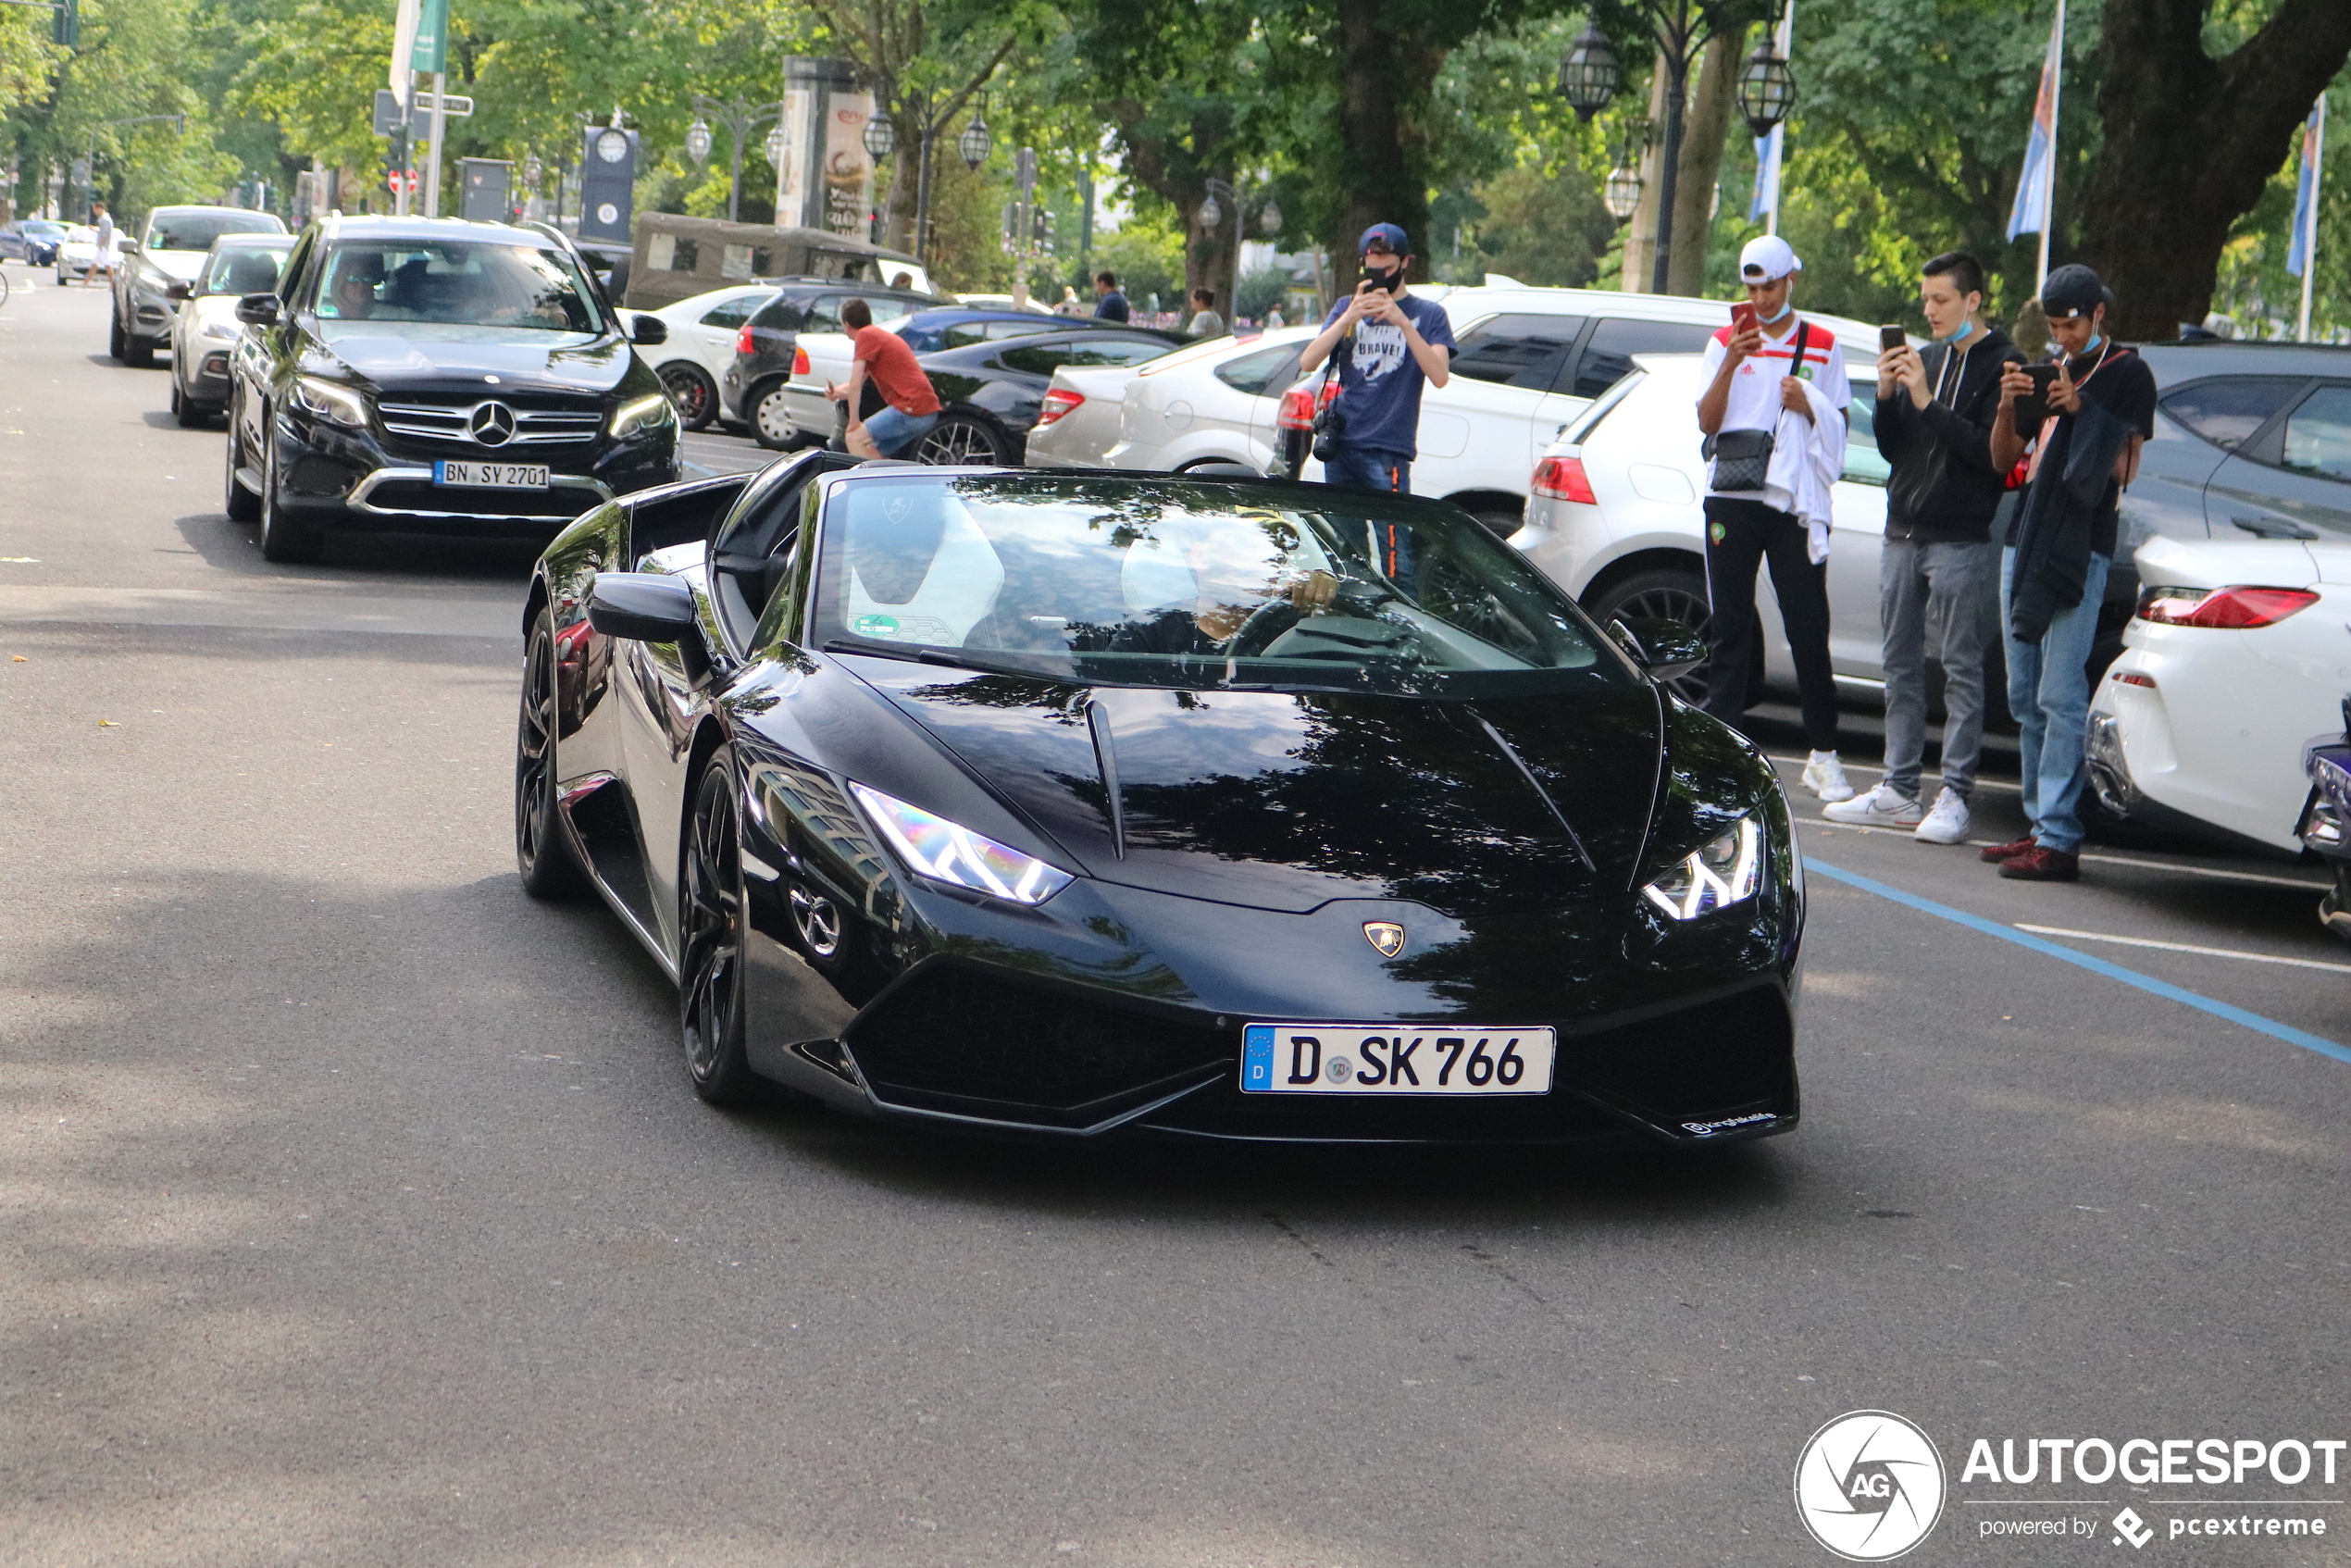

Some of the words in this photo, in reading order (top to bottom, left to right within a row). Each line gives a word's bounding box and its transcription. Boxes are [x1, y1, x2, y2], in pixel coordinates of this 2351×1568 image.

[1359, 342, 1400, 357] BRAVE!
[446, 464, 467, 481] BN
[481, 466, 502, 483] SY
[507, 467, 547, 486] 2701
[871, 616, 884, 626] 4
[1287, 1036, 1322, 1085] D
[1356, 1036, 1424, 1086] SK
[1436, 1037, 1525, 1087] 766
[1252, 1065, 1264, 1079] D
